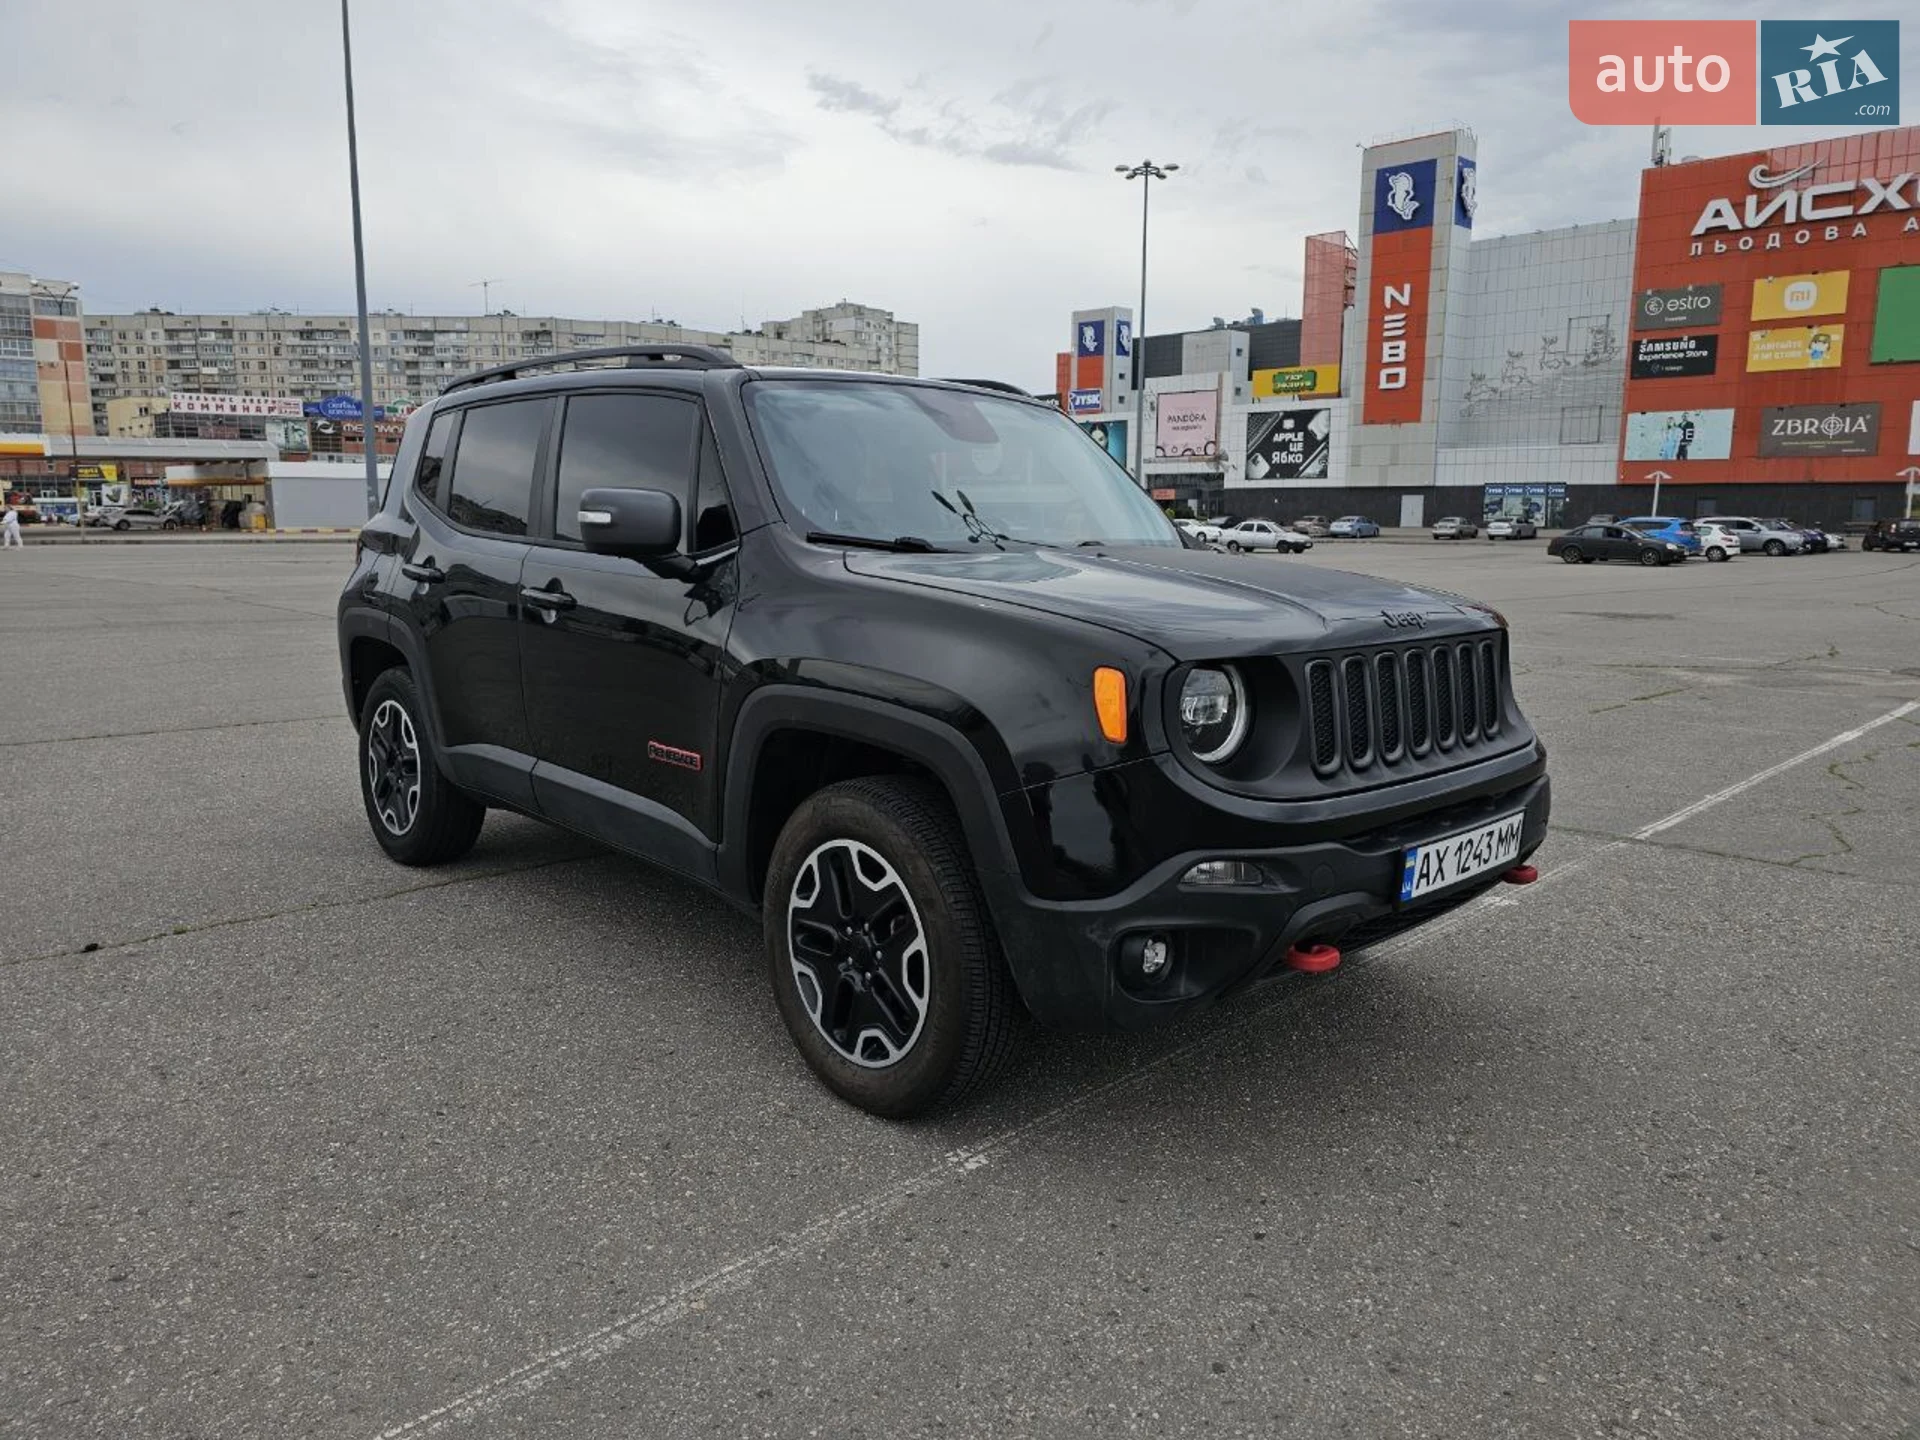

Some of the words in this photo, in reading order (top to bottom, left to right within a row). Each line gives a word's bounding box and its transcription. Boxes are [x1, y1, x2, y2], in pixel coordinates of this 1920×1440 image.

[1691, 158, 1920, 236] АЙСХ
[1689, 222, 1867, 256] ЛЬОДОВА
[1667, 296, 1711, 311] estro
[1640, 340, 1696, 353] SAMSUNG
[1639, 352, 1685, 362] Experience
[1686, 350, 1708, 358] Store
[1075, 394, 1100, 406] JYSK
[1167, 413, 1207, 423] PANDORA
[1273, 432, 1304, 442] APPLE
[1289, 442, 1304, 452] ЦЕ
[1381, 610, 1427, 629] Jeep
[1415, 846, 1449, 890] AX
[1454, 830, 1494, 876] 1243
[1496, 819, 1521, 860] MM
